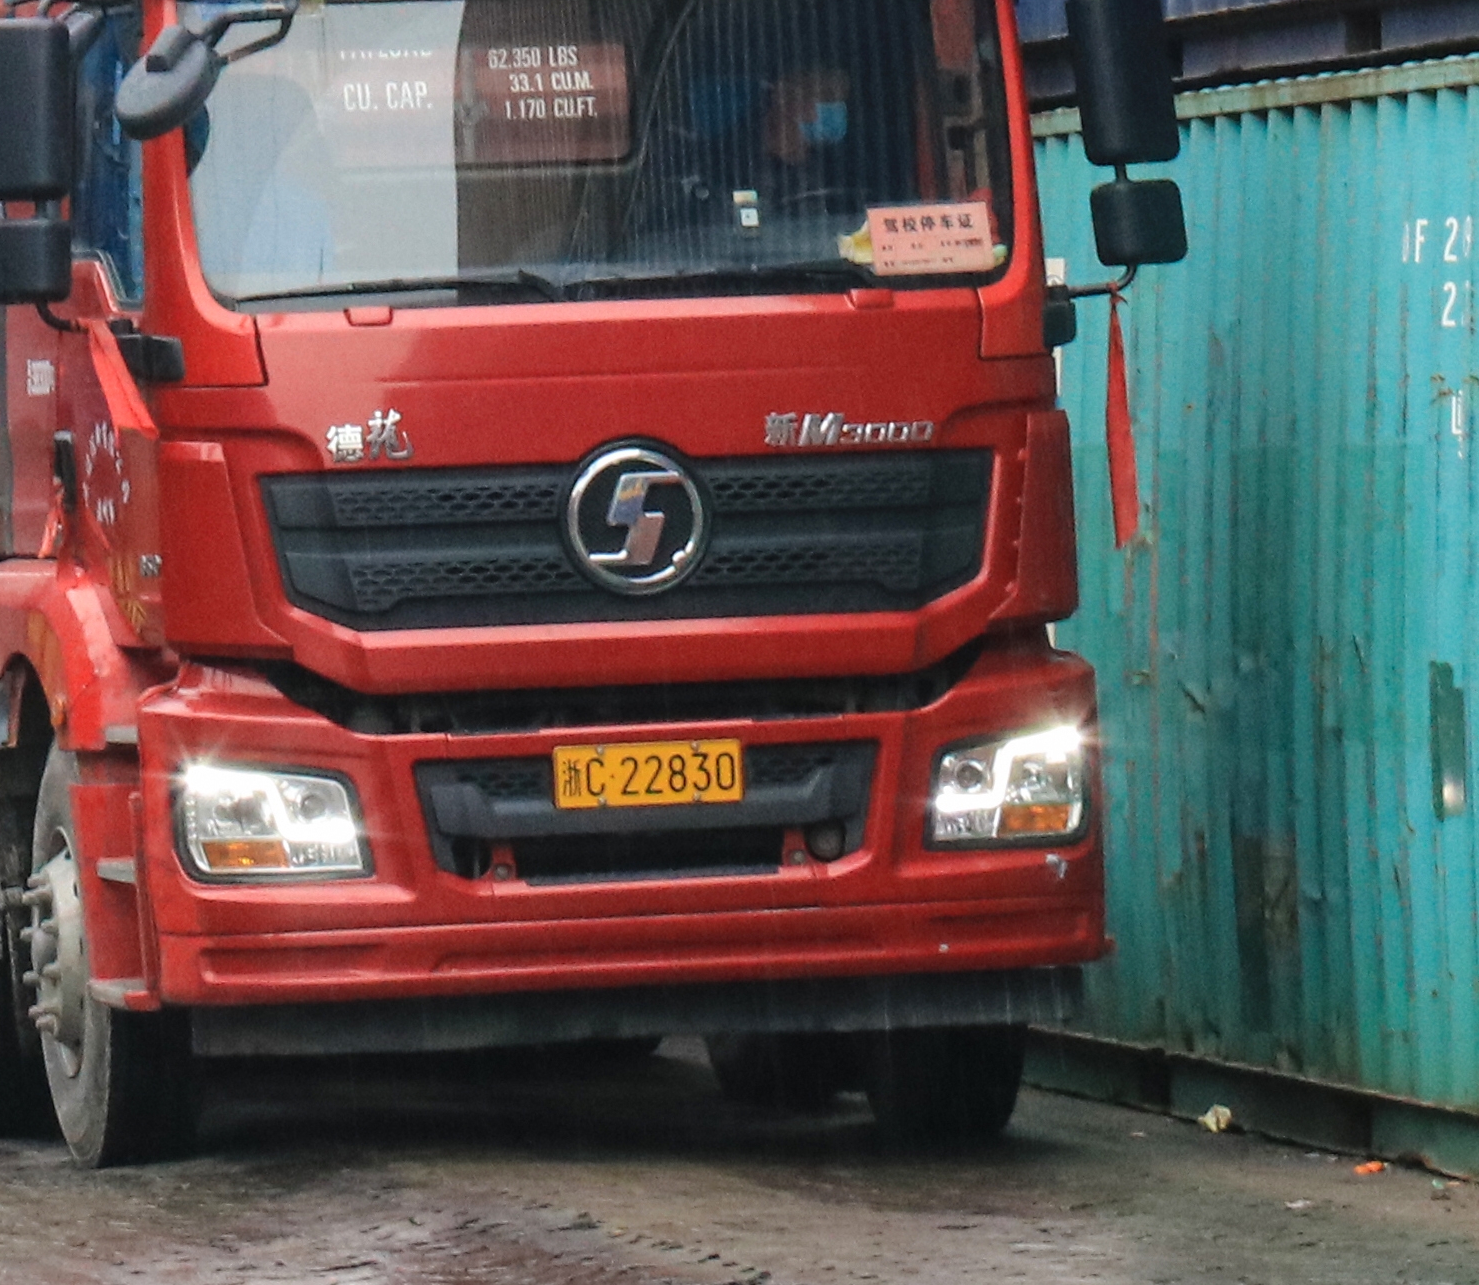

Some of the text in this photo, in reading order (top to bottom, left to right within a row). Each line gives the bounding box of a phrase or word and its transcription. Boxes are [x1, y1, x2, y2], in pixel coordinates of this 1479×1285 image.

[549, 45, 578, 67] LBS
[343, 80, 434, 112] CU. CAP.
